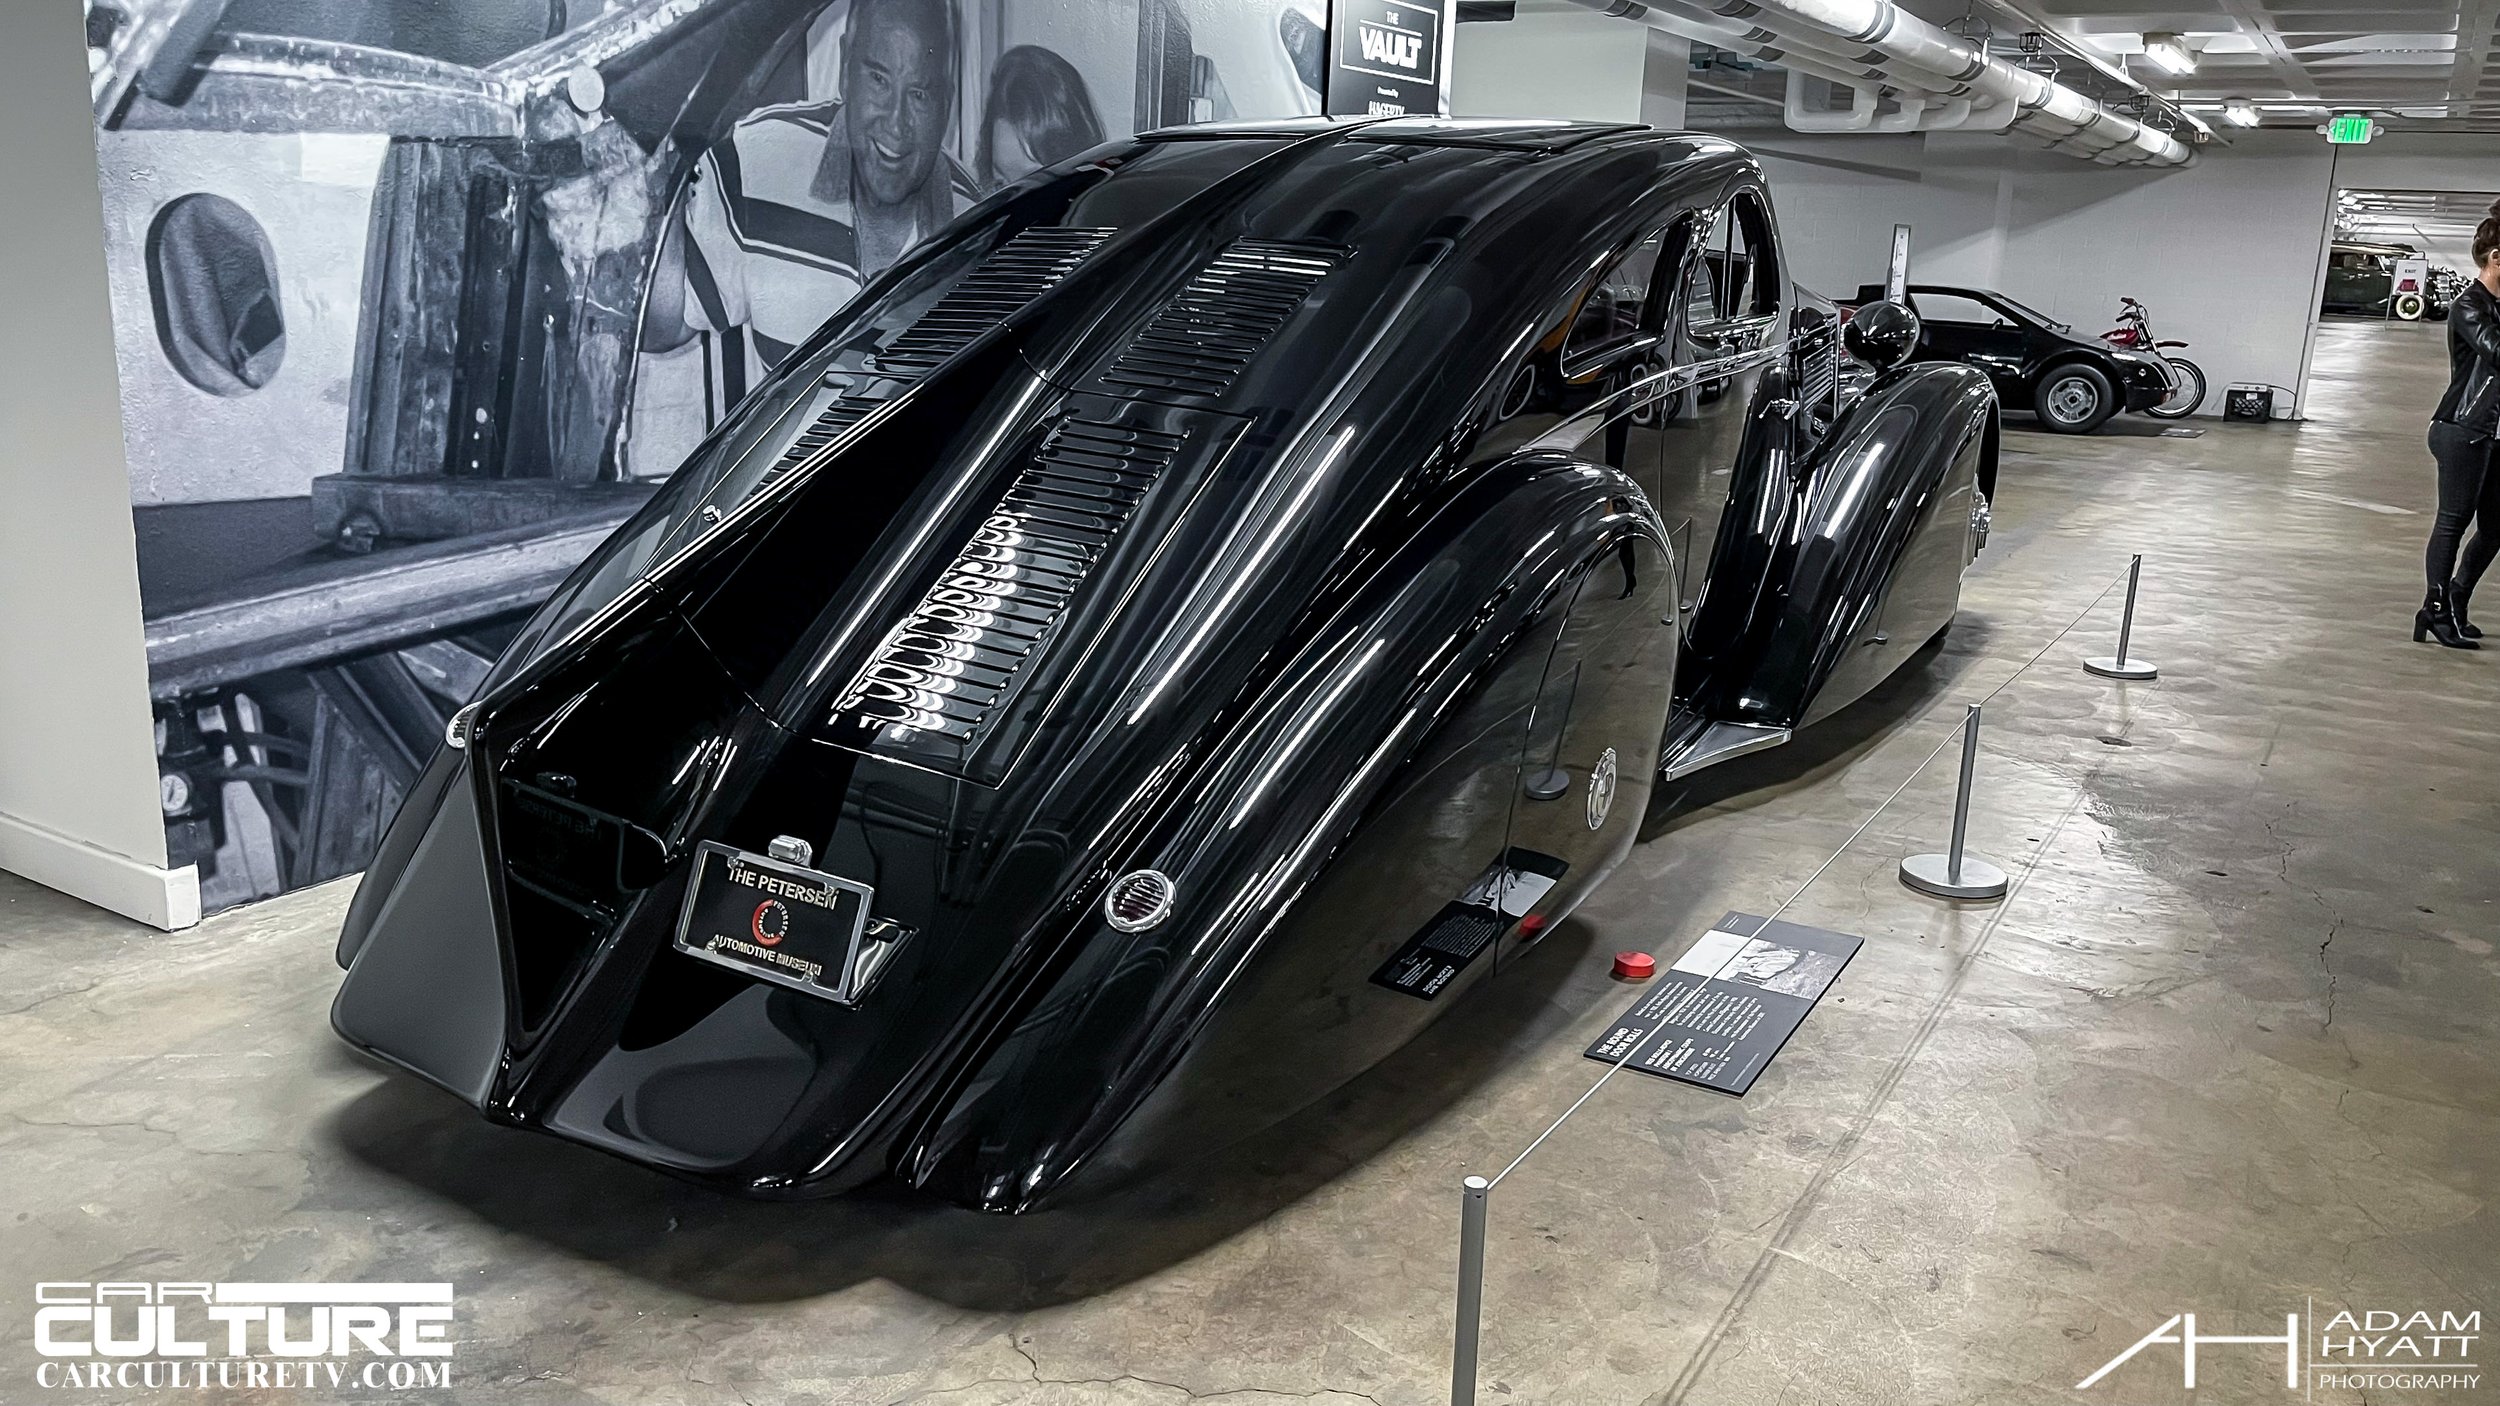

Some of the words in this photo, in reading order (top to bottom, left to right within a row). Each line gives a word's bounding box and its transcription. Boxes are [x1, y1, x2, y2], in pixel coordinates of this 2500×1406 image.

[1386, 11, 1399, 24] THE
[1359, 27, 1422, 69] VAULT
[2334, 118, 2369, 142] EXIT
[728, 866, 757, 887] THE
[758, 875, 839, 910] PETERSEN
[713, 934, 777, 962] AUTOMOTIVE
[776, 953, 822, 976] MUSEUM
[1596, 1043, 1613, 1054] THE
[1606, 1027, 1629, 1045] ROUND
[1610, 1042, 1630, 1057] DOOR
[1623, 1028, 1644, 1043] ROLLS
